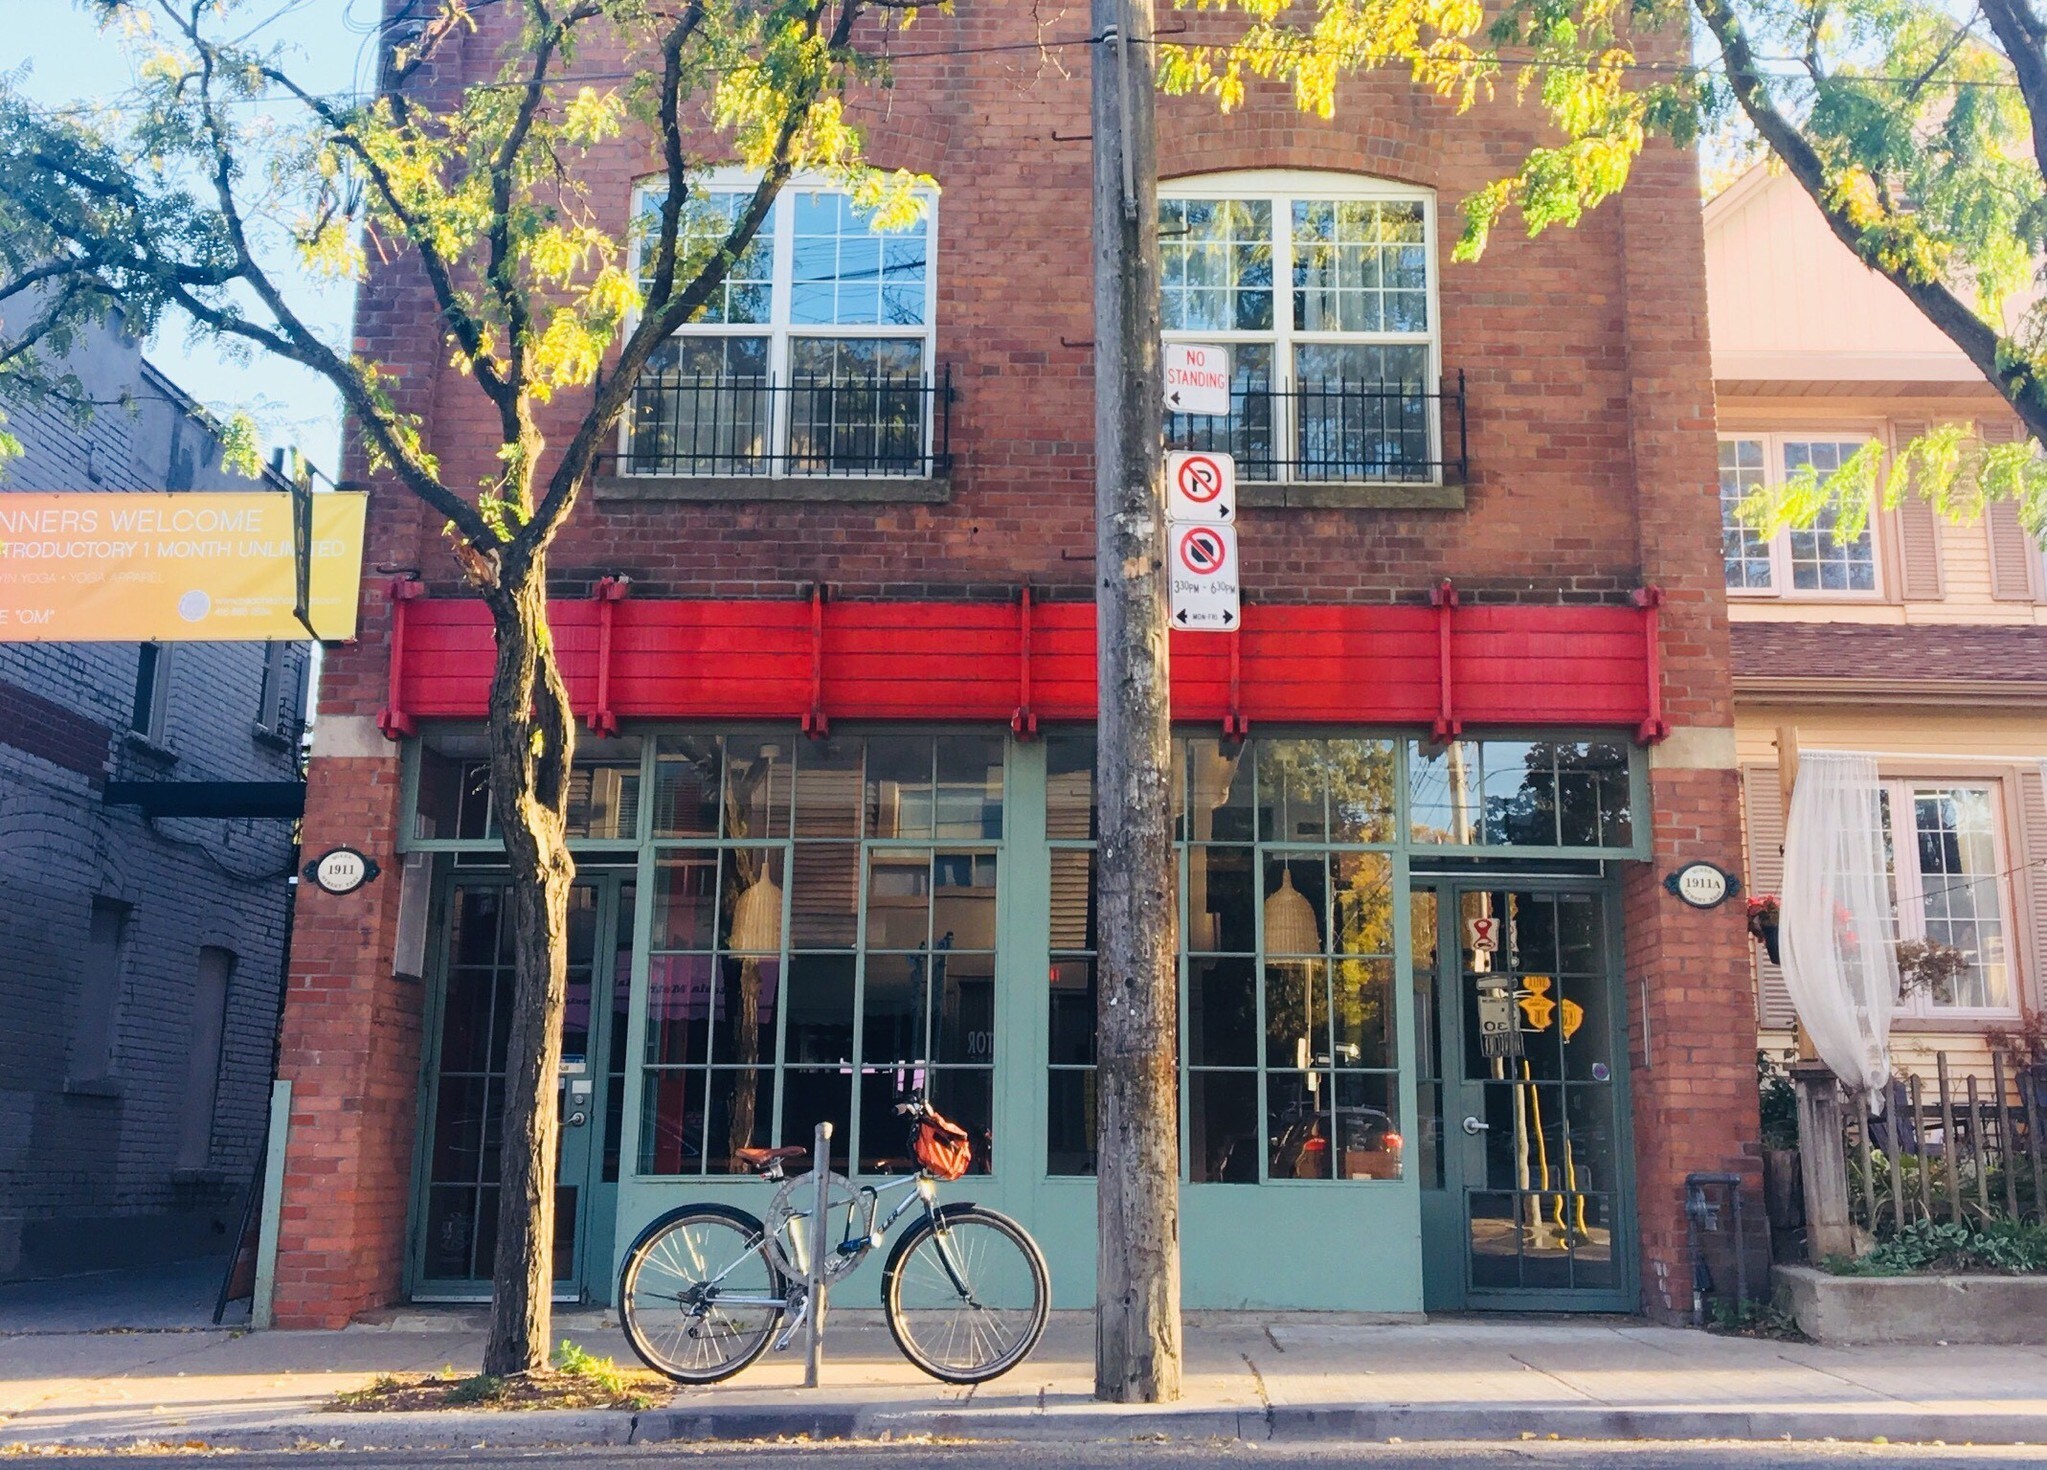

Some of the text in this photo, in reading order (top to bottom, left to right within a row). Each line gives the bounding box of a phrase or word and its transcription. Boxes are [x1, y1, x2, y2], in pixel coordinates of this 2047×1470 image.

[1187, 350, 1205, 367] NO
[1168, 368, 1225, 389] STANDING
[110, 509, 263, 533] WELCOME
[143, 541, 151, 559] 1
[157, 540, 232, 559] MONTH
[21, 572, 57, 584] YOGA
[70, 572, 105, 584] YOGA
[328, 864, 354, 875] 1911
[1686, 878, 1721, 889] 1911A
